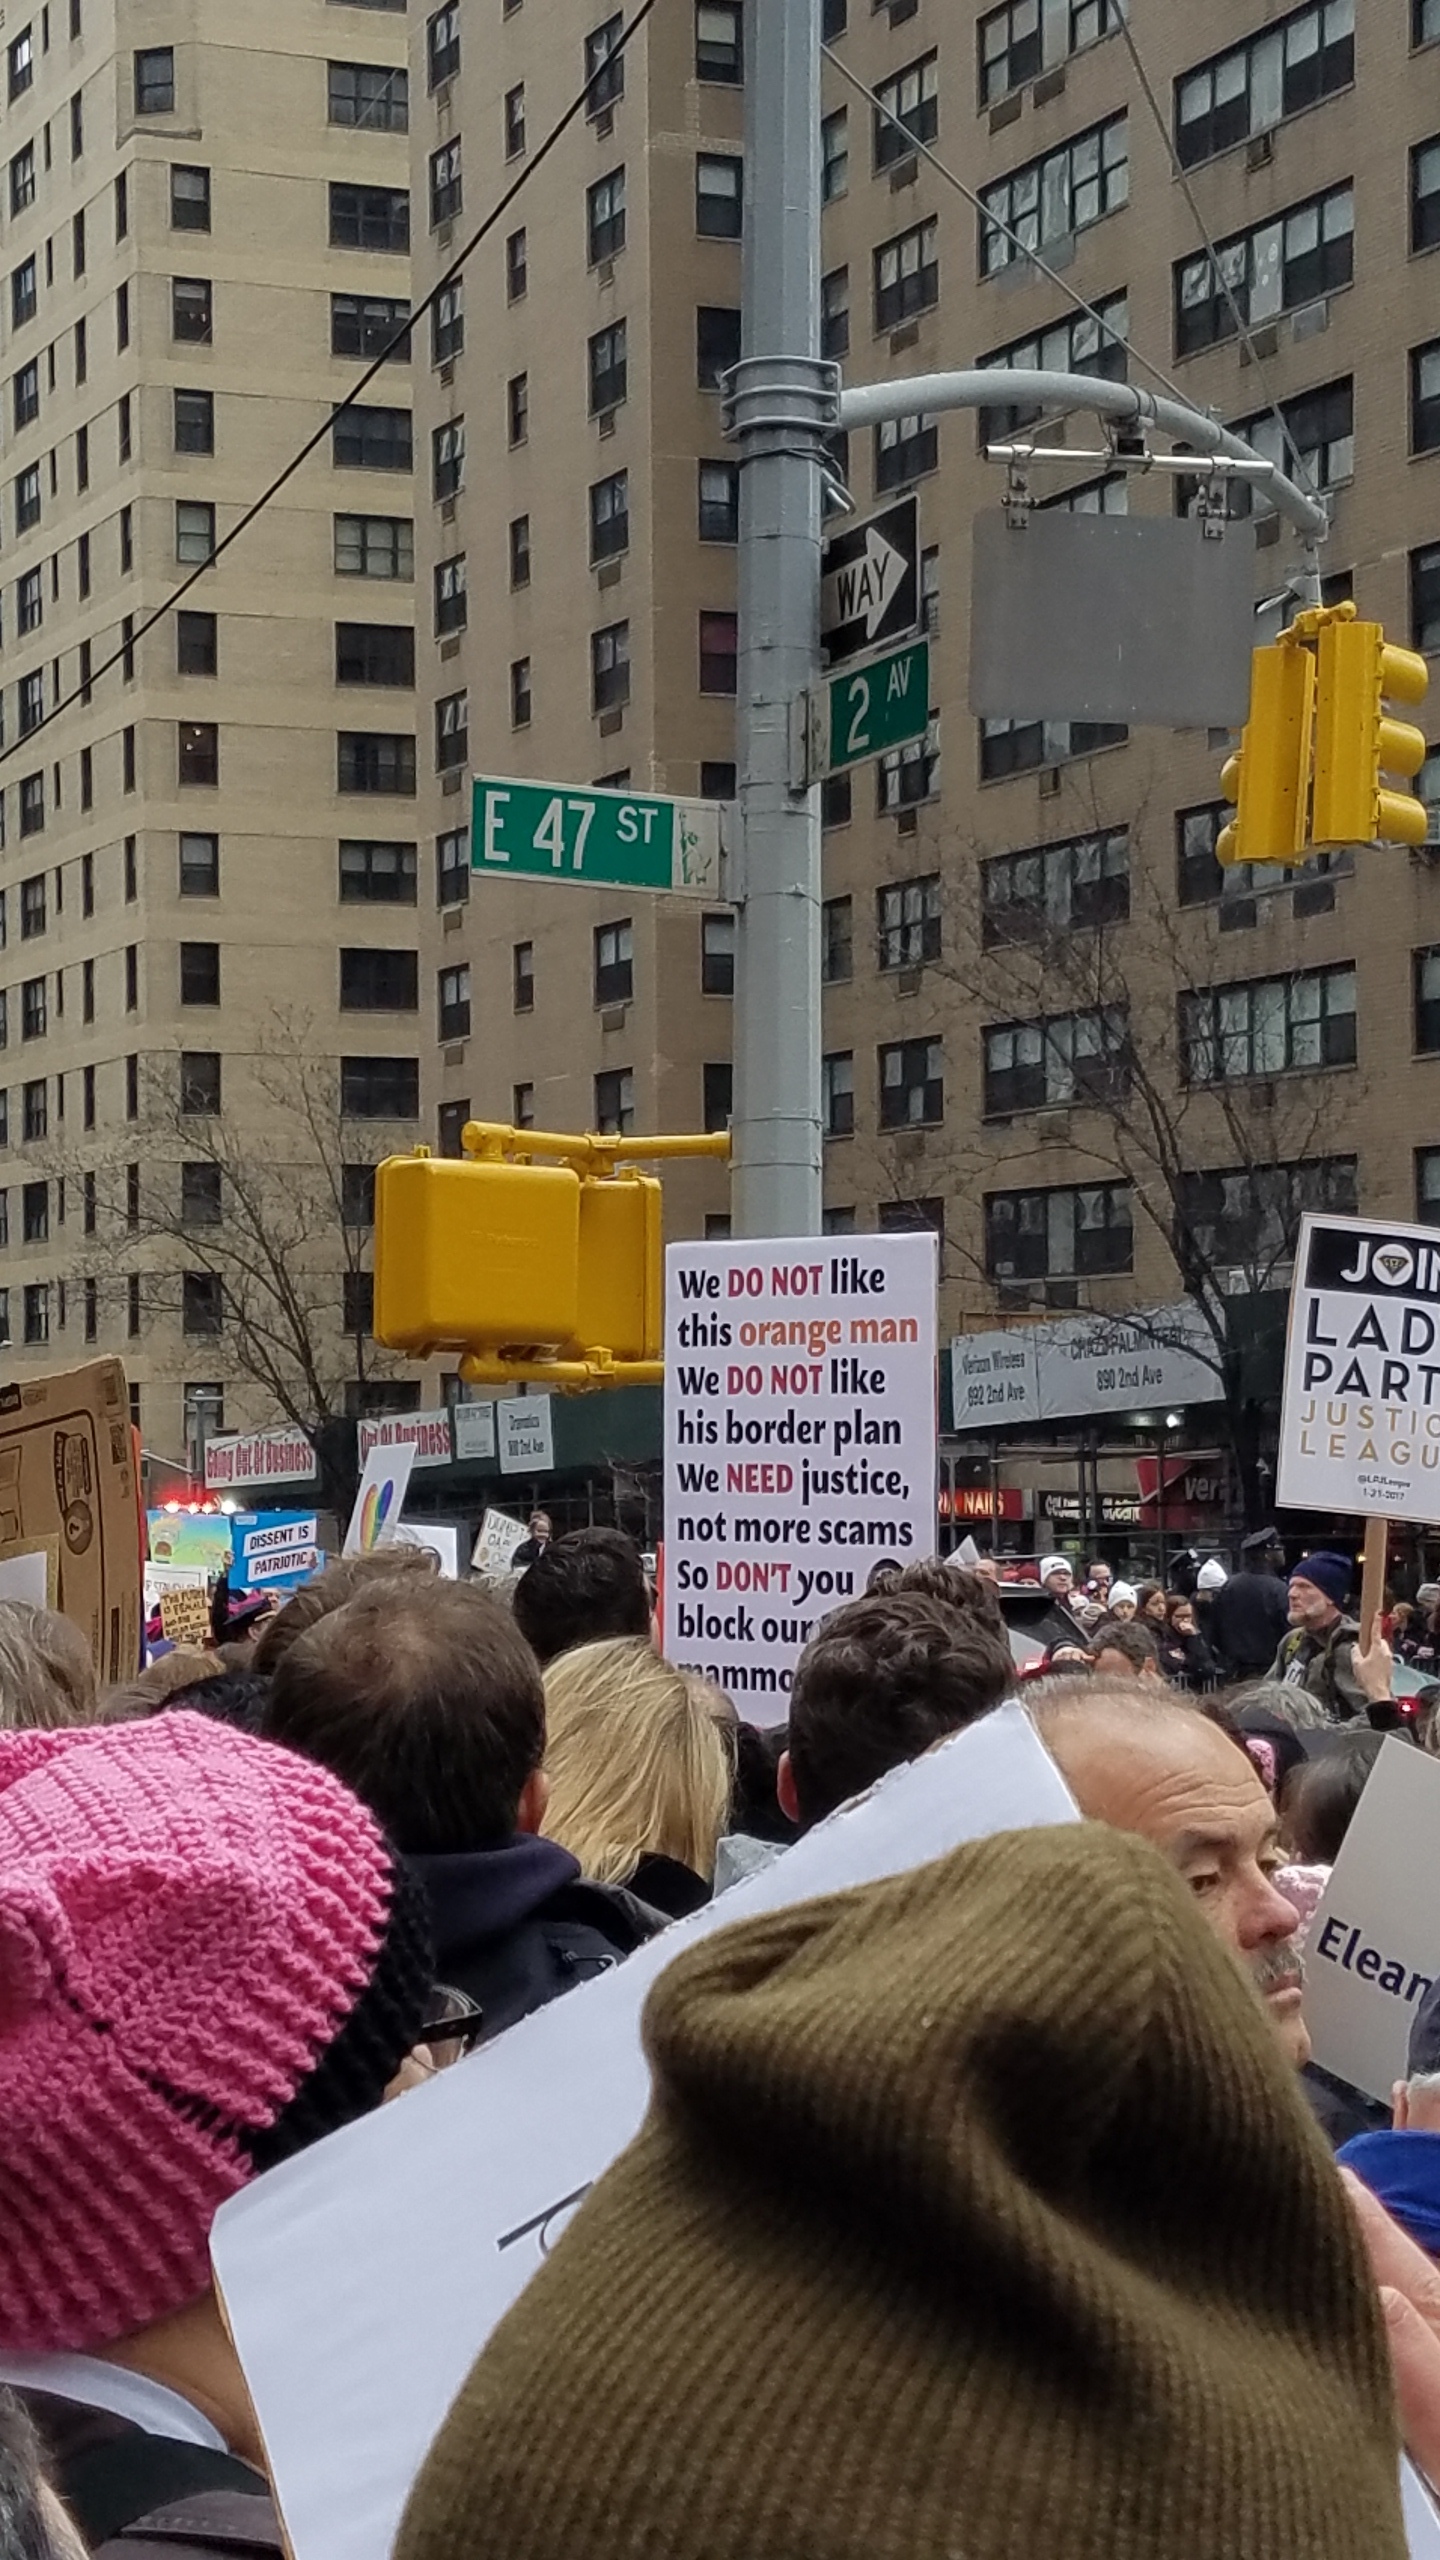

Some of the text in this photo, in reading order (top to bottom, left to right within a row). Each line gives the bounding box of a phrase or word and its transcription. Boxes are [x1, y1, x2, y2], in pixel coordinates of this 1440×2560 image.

[837, 551, 890, 620] WAY
[847, 656, 913, 752] 2 AV
[484, 790, 658, 870] E 47 ST
[678, 1258, 885, 1298] We DO NOT like
[677, 1311, 918, 1357] this orange man
[1306, 1297, 1436, 1356] LAD
[677, 1358, 885, 1396] We DO NOT like
[962, 1354, 991, 1375] Verizon
[1097, 1364, 1163, 1391] 890 2nd Ave
[1303, 1350, 1440, 1405] PART
[987, 1383, 1004, 1403] 2nd
[1007, 1381, 1025, 1401] Ave
[677, 1408, 901, 1456] his border plan
[1300, 1430, 1440, 1469] LEAGU
[676, 1458, 909, 1505] We NEED justice,
[298, 1525, 309, 1539] IS
[677, 1512, 913, 1547] not more scams
[254, 1551, 307, 1575] PATRIOTIC
[677, 1560, 854, 1606] So DON'T you
[677, 1603, 815, 1644] block our
[1316, 1916, 1433, 2002] Elean
